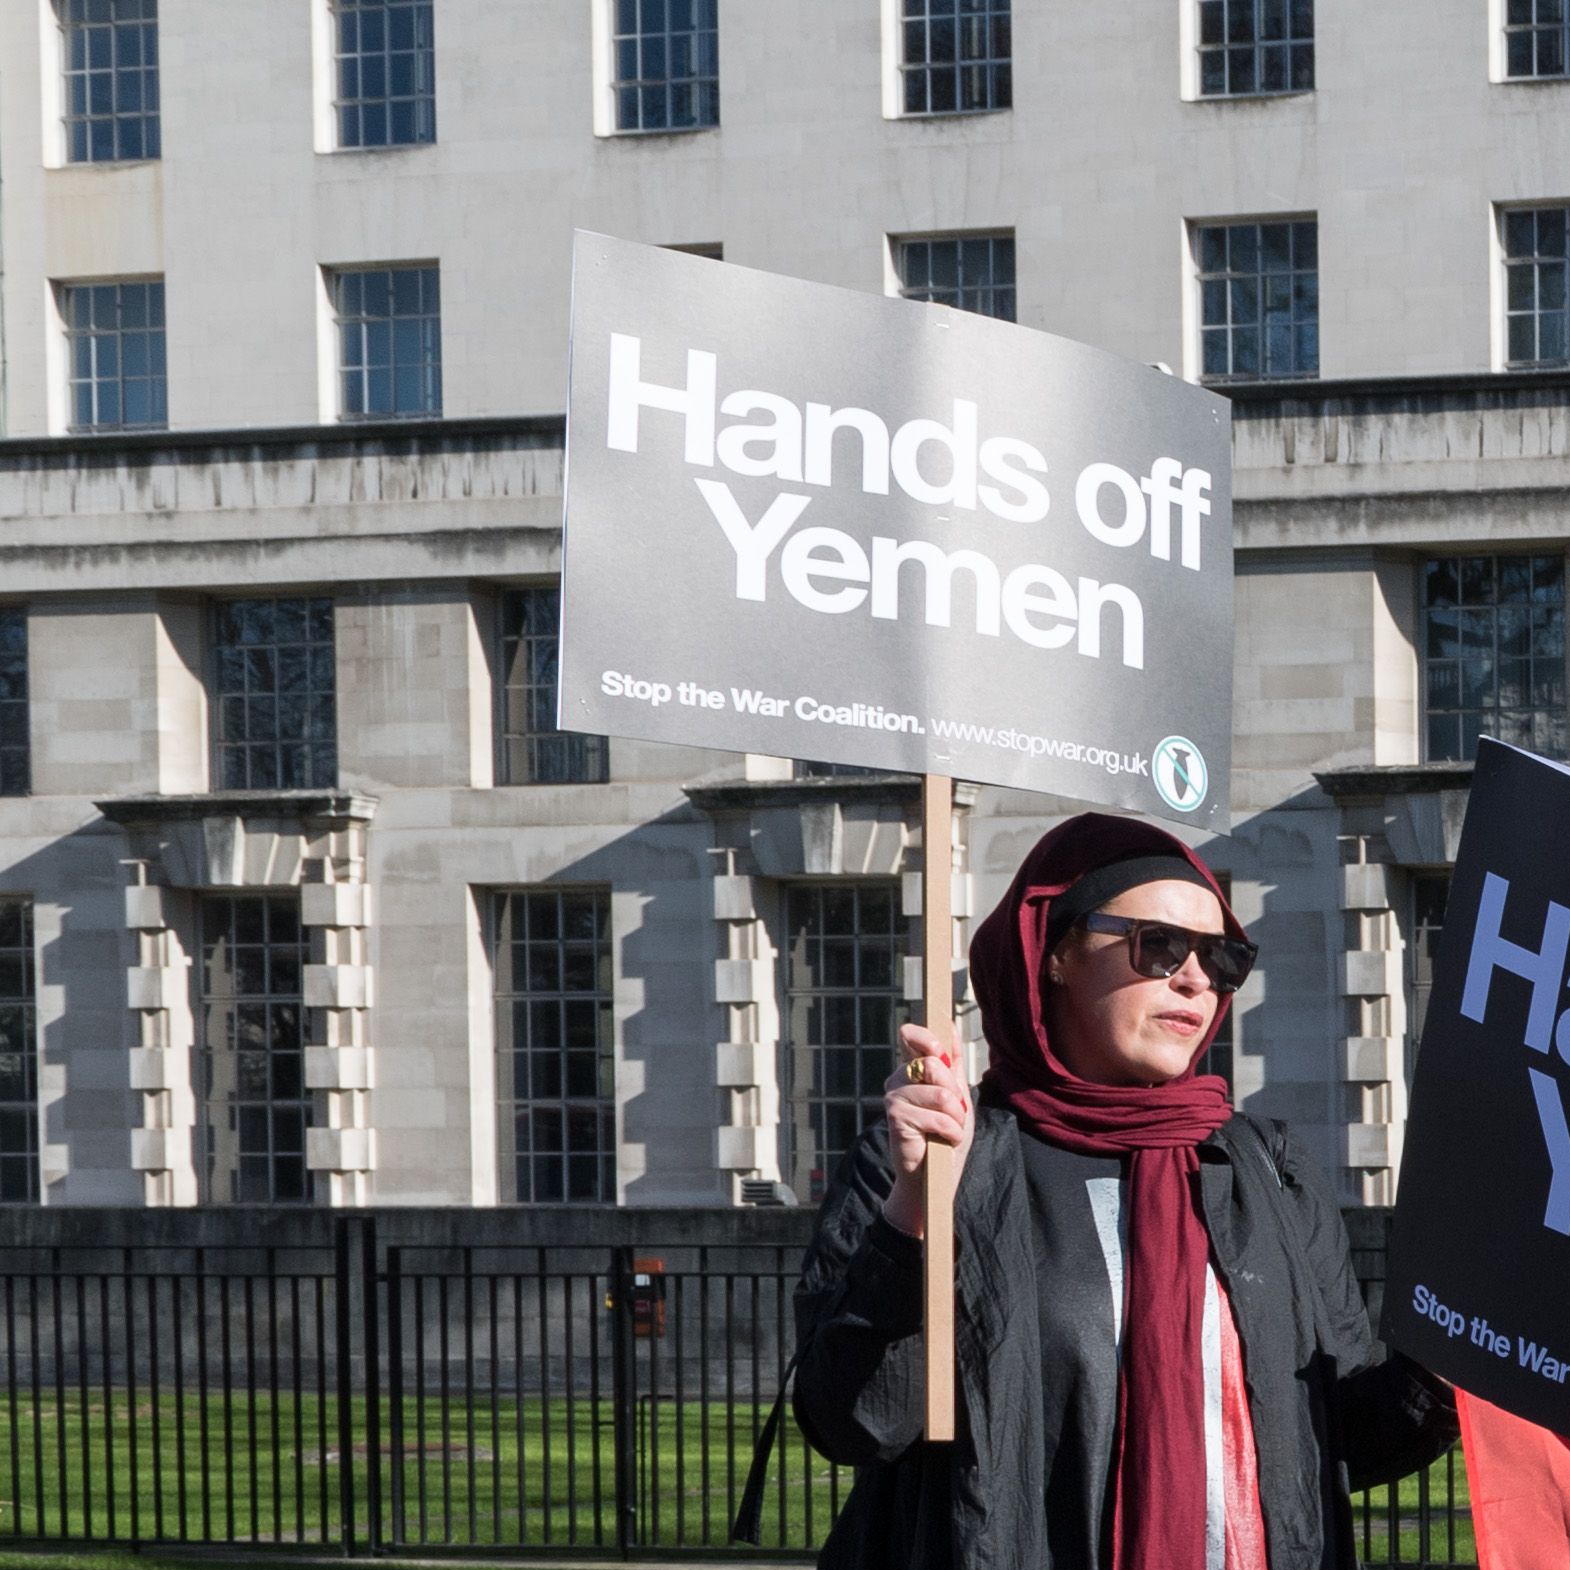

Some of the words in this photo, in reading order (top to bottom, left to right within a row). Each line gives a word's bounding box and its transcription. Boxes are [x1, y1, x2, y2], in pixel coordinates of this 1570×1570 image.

[607, 332, 1050, 523] Hands
[1075, 458, 1210, 570] off
[694, 478, 1143, 669] Yemen
[601, 670, 672, 707] Stop
[676, 681, 726, 710] the
[730, 687, 791, 717] War
[794, 696, 926, 735] Coalition.
[930, 718, 1148, 777] www.stopwar.org.uk
[1412, 1284, 1465, 1338] Stop
[1470, 1316, 1511, 1358] the
